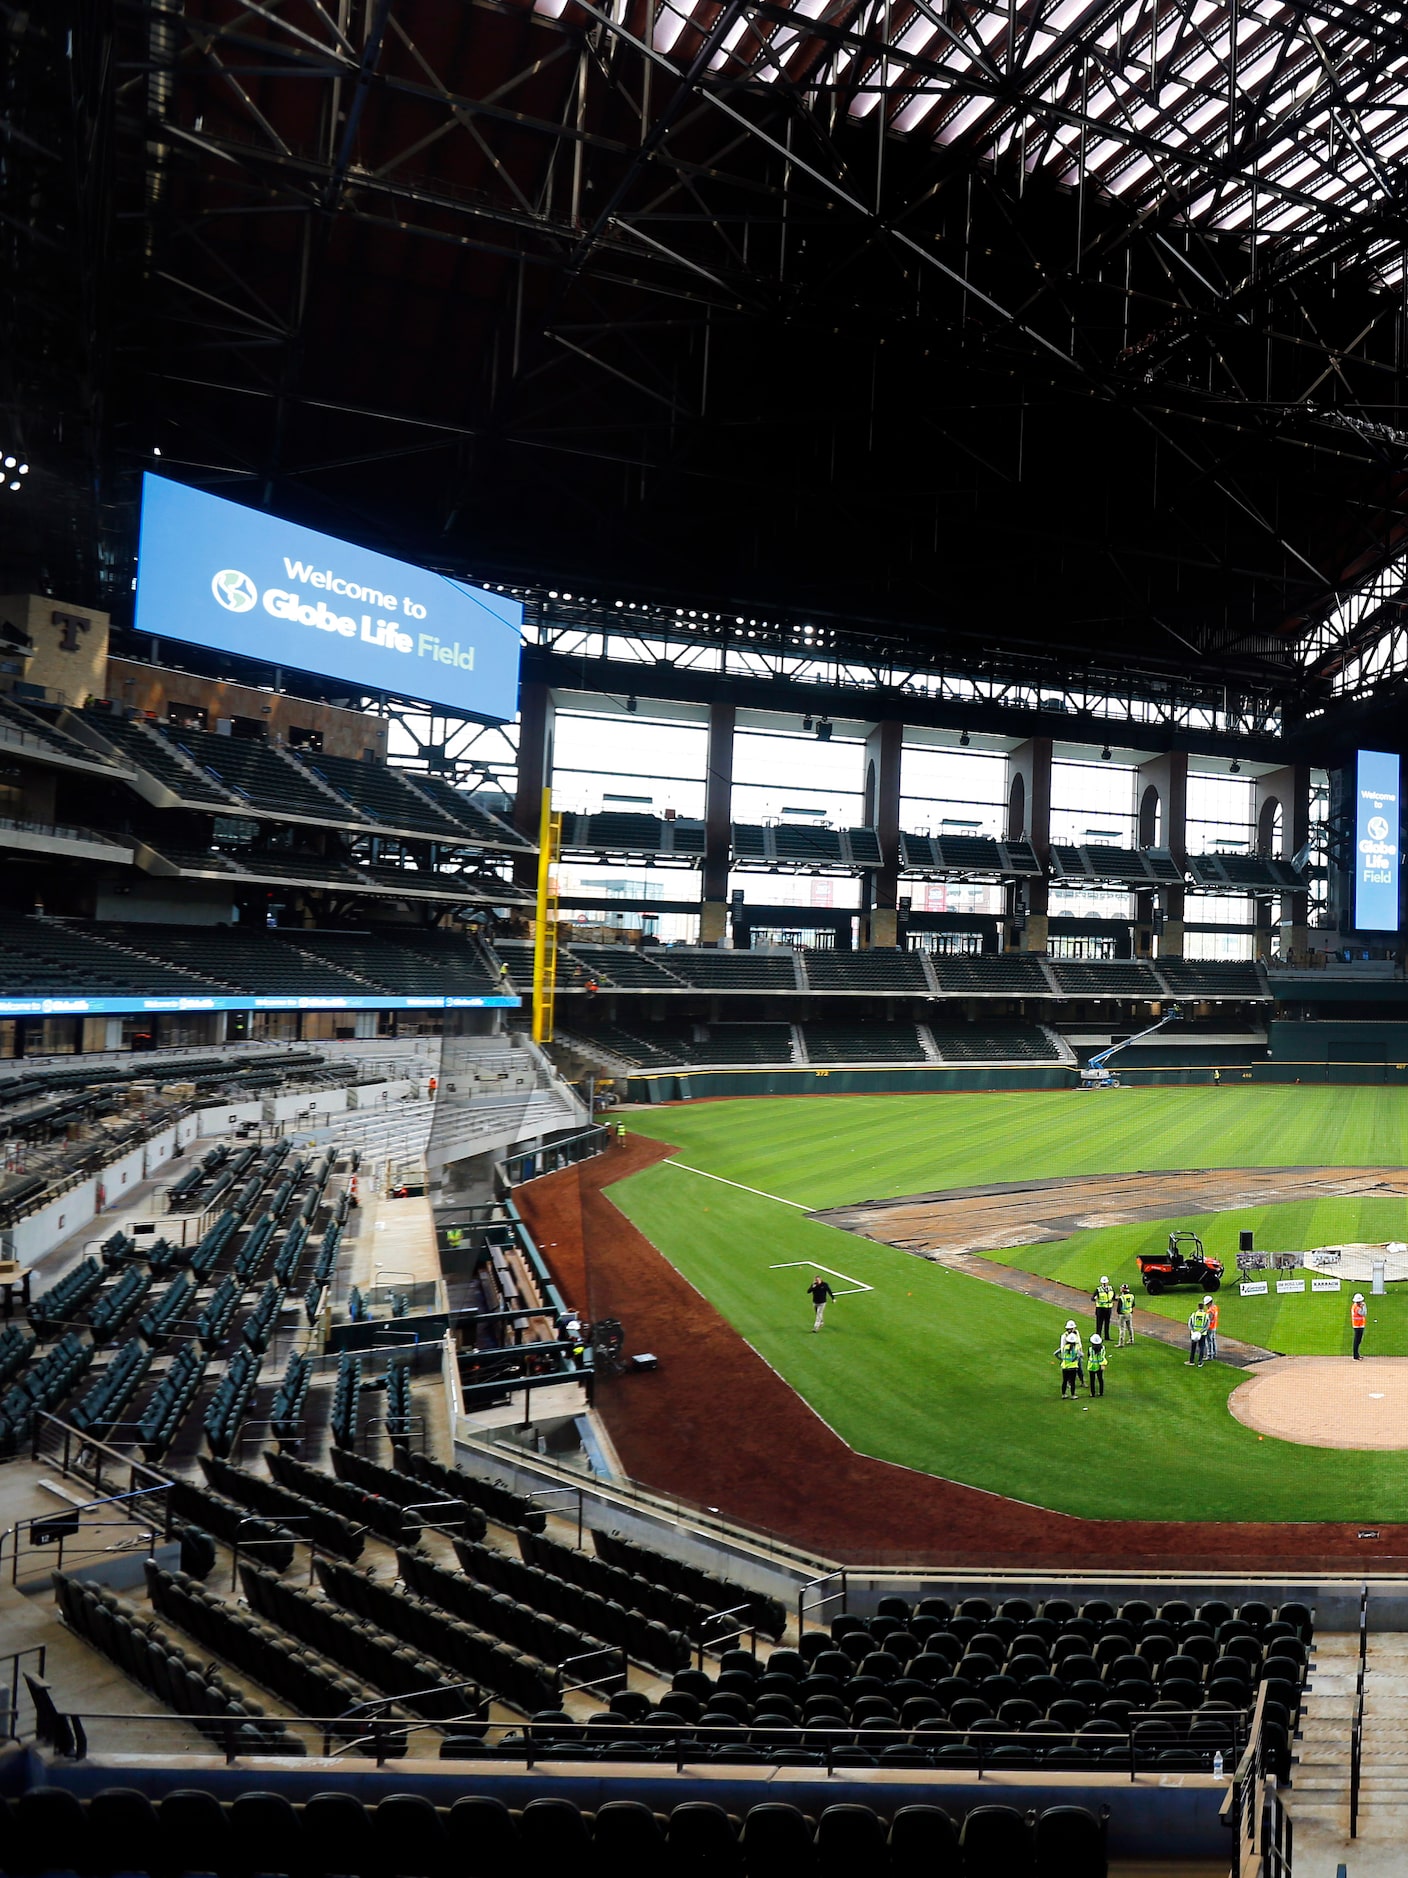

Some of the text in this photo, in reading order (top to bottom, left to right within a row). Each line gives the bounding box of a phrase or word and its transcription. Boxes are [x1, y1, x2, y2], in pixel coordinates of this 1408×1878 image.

[283, 556, 428, 620] Welcome to
[52, 610, 92, 652] T
[262, 588, 475, 671] Globe Life Field
[1361, 790, 1396, 802] Welcome
[1373, 800, 1384, 809] to
[1359, 839, 1396, 856] Globe
[1365, 854, 1390, 870] Life
[1363, 870, 1392, 884] Field
